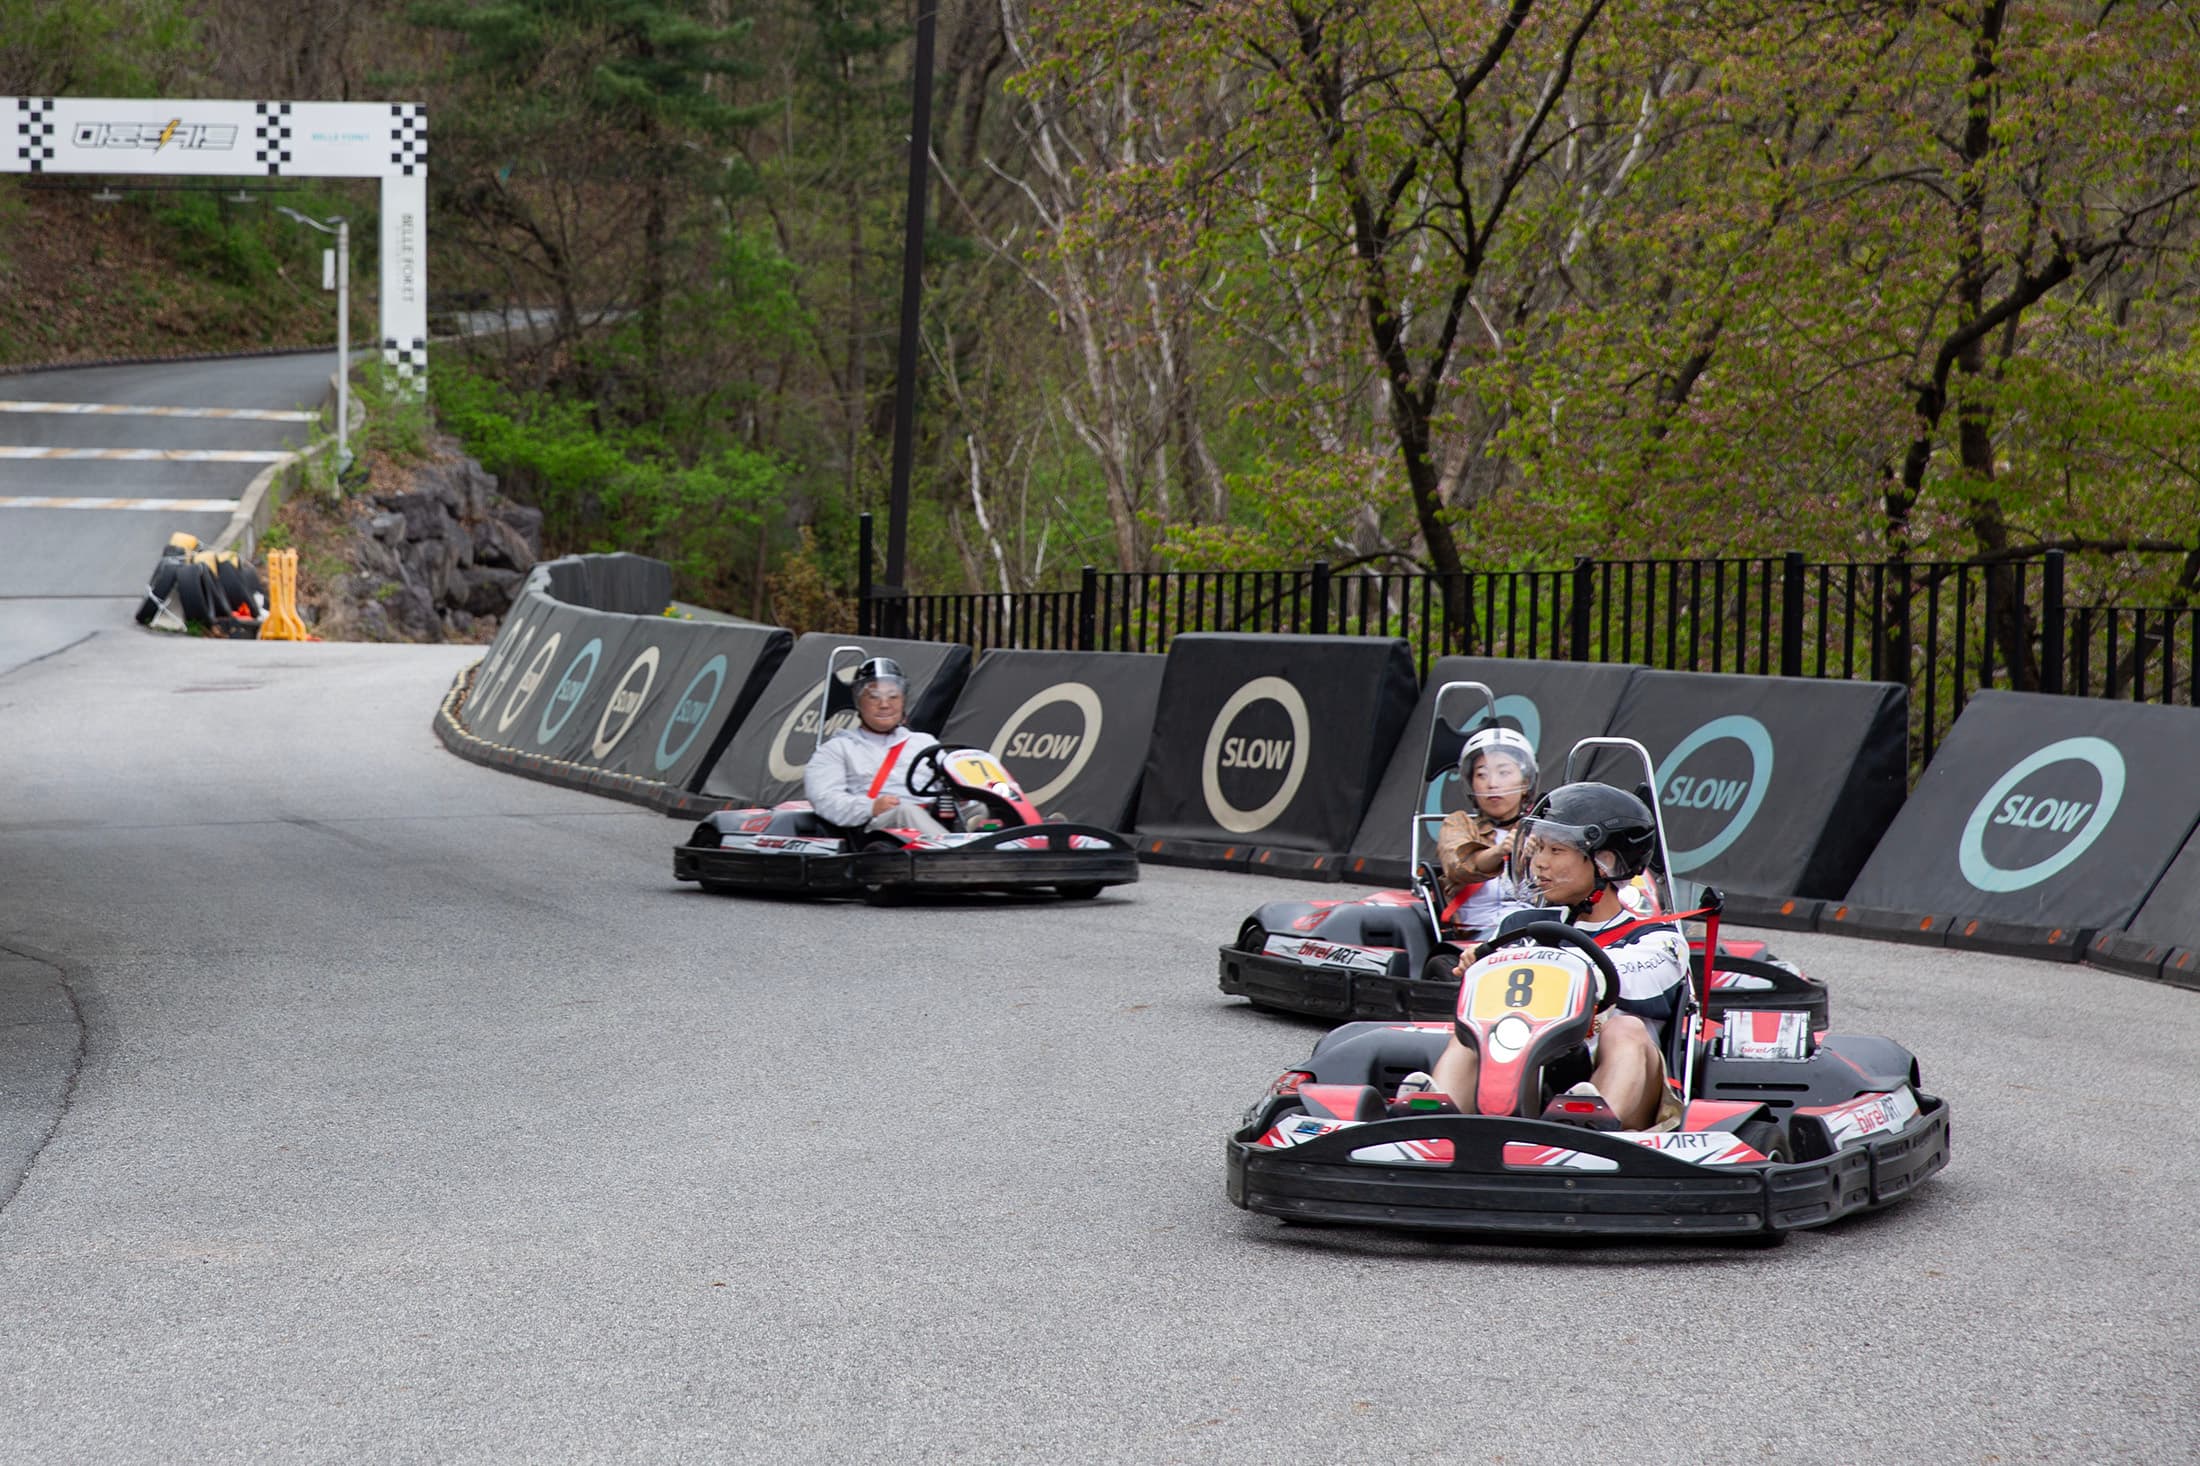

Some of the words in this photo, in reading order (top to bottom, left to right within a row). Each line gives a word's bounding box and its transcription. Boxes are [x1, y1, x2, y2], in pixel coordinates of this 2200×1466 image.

[1006, 732, 1080, 760] SLOW
[1221, 737, 1292, 769] SLOW
[967, 760, 990, 779] 7
[1663, 775, 1748, 811] SLOW
[1993, 794, 2093, 832] SLOW
[1504, 968, 1535, 1008] 8
[1637, 1133, 1709, 1150] elART
